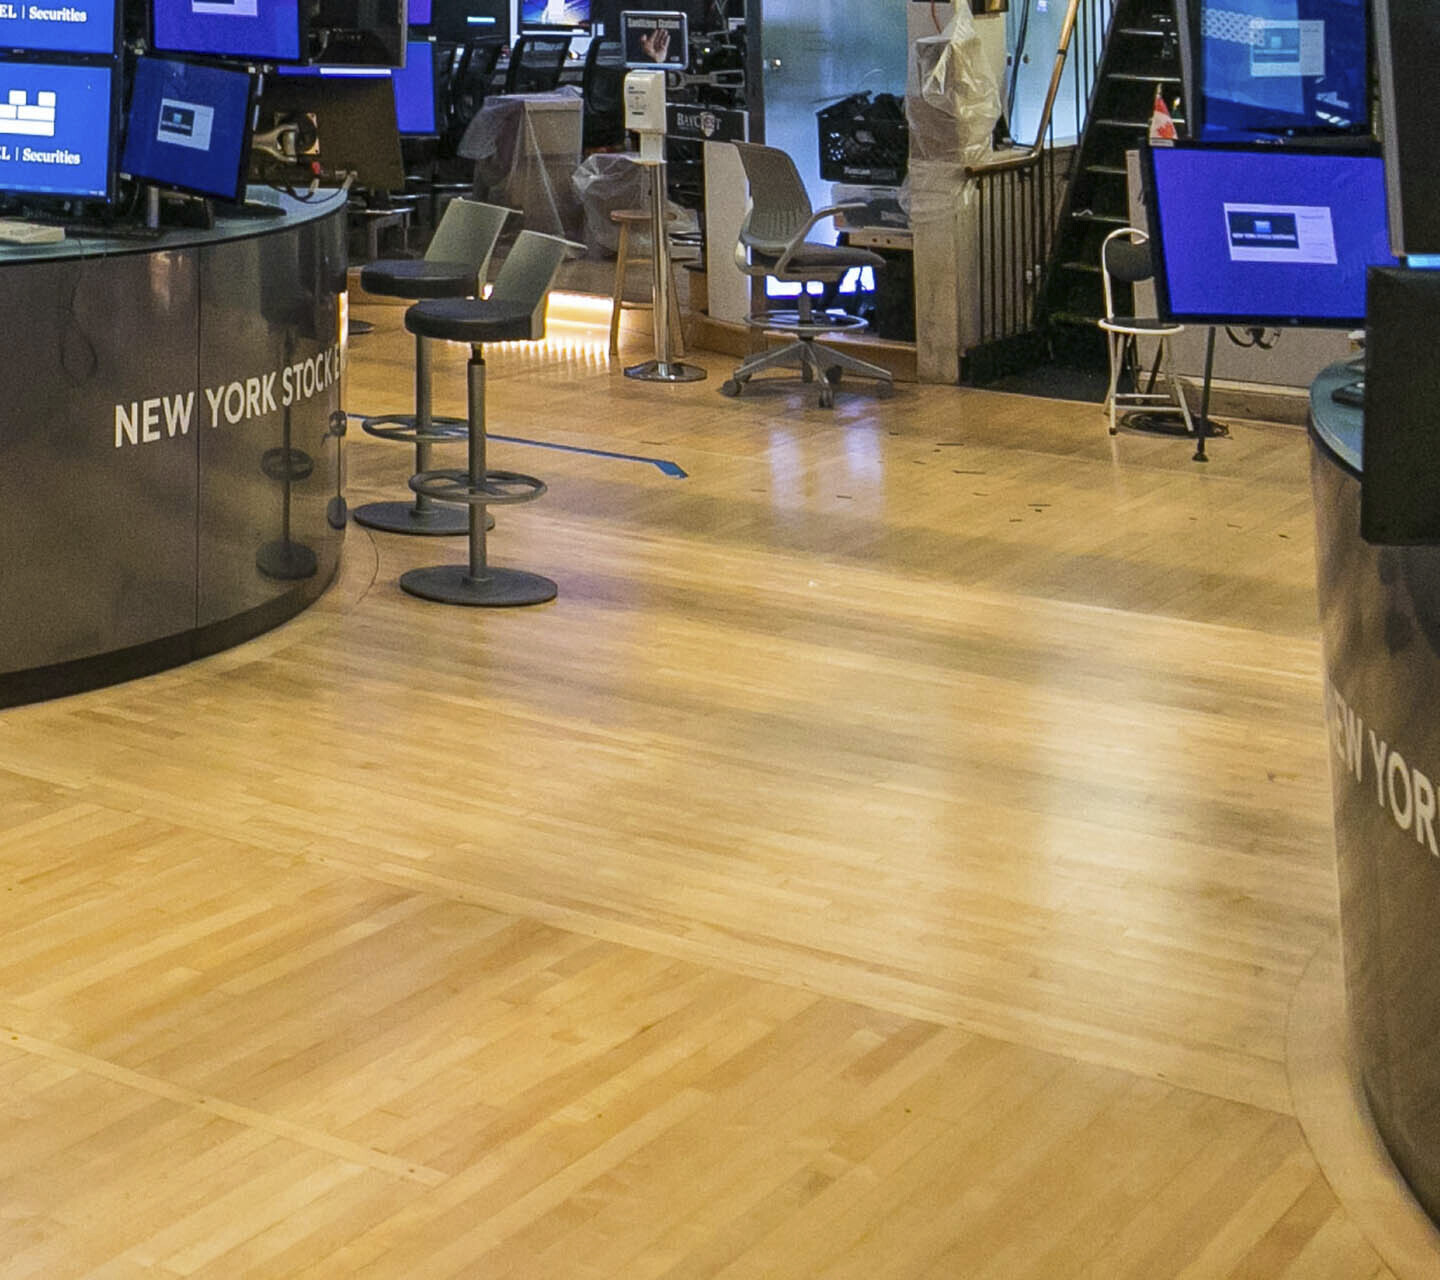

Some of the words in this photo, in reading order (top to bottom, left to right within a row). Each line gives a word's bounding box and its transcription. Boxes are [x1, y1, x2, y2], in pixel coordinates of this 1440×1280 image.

[29, 6, 87, 23] Securities
[22, 147, 81, 165] Securities
[113, 392, 194, 449] NEW
[204, 368, 276, 430] YORK
[281, 355, 333, 406] STOCK
[1331, 690, 1366, 786] EW
